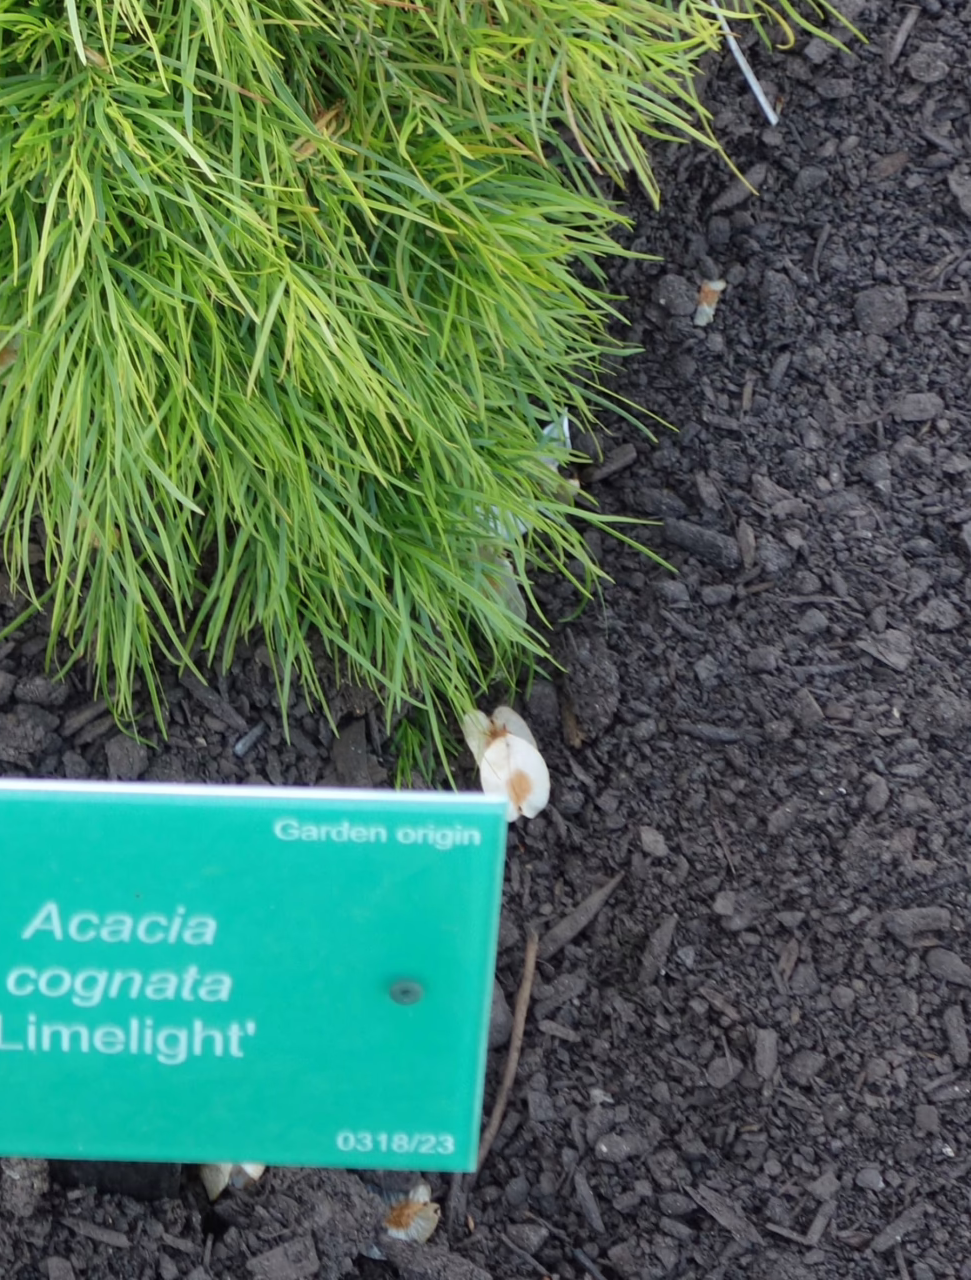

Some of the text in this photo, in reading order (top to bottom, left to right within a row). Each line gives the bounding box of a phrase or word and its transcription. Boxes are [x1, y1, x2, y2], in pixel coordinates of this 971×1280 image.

[273, 817, 482, 850] Garden origin
[22, 901, 218, 946] Acacia
[5, 963, 233, 1007] cognata
[336, 1130, 456, 1155] 0318/23
